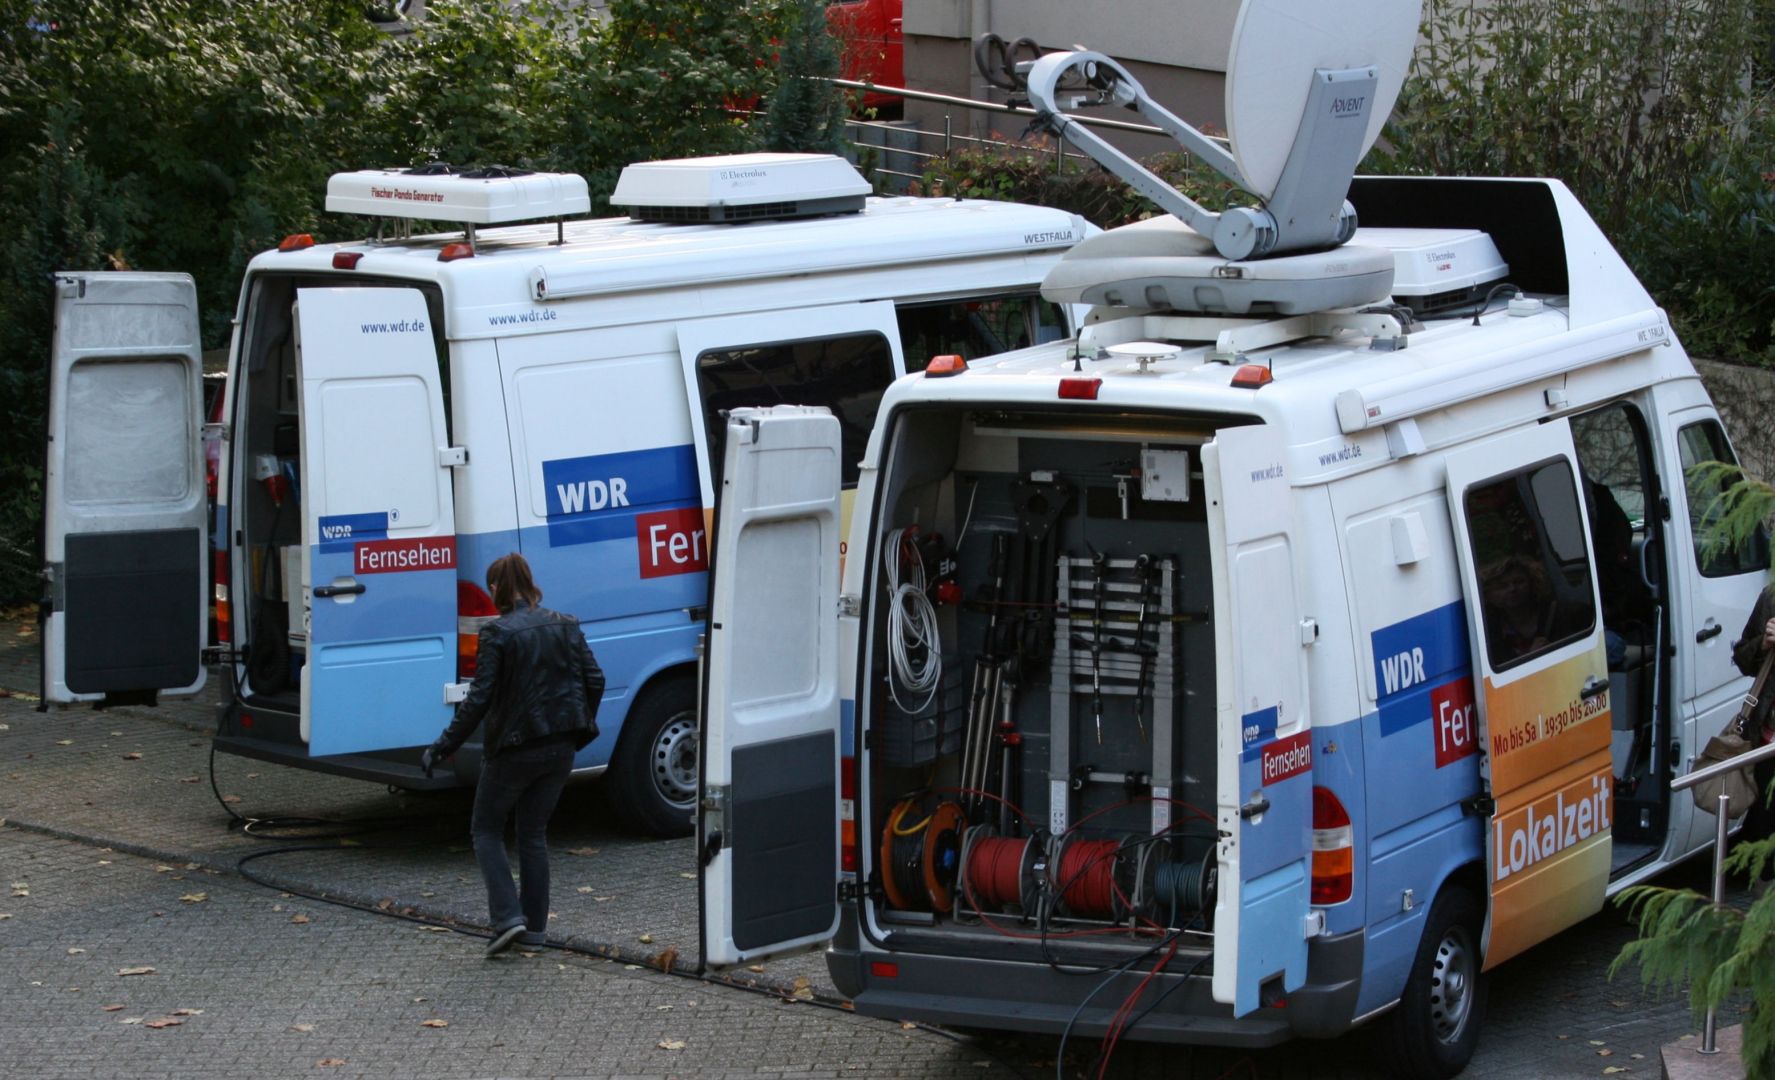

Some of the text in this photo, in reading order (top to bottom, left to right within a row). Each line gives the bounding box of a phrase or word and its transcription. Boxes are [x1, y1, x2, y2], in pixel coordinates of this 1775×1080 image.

[728, 169, 768, 180] Electrolux
[371, 187, 393, 199] Fischer
[1024, 230, 1073, 245] WESTFALIA
[361, 319, 425, 334] www.wdr.de
[488, 308, 557, 326] www.wdr.de
[1318, 442, 1362, 467] www.wdr.de
[556, 477, 630, 514] WDR
[322, 524, 353, 540] WDR
[359, 542, 452, 570] Fernsehen
[1381, 646, 1427, 696] WDR
[1439, 700, 1473, 752] Fer
[1493, 733, 1509, 758] Mo
[1509, 725, 1524, 751] bis
[1524, 721, 1538, 745] Sa
[1544, 710, 1569, 738] 19:30
[1569, 699, 1583, 723] bis
[1264, 741, 1310, 780] Fernsehen
[1496, 774, 1610, 881] Lokalzeit
